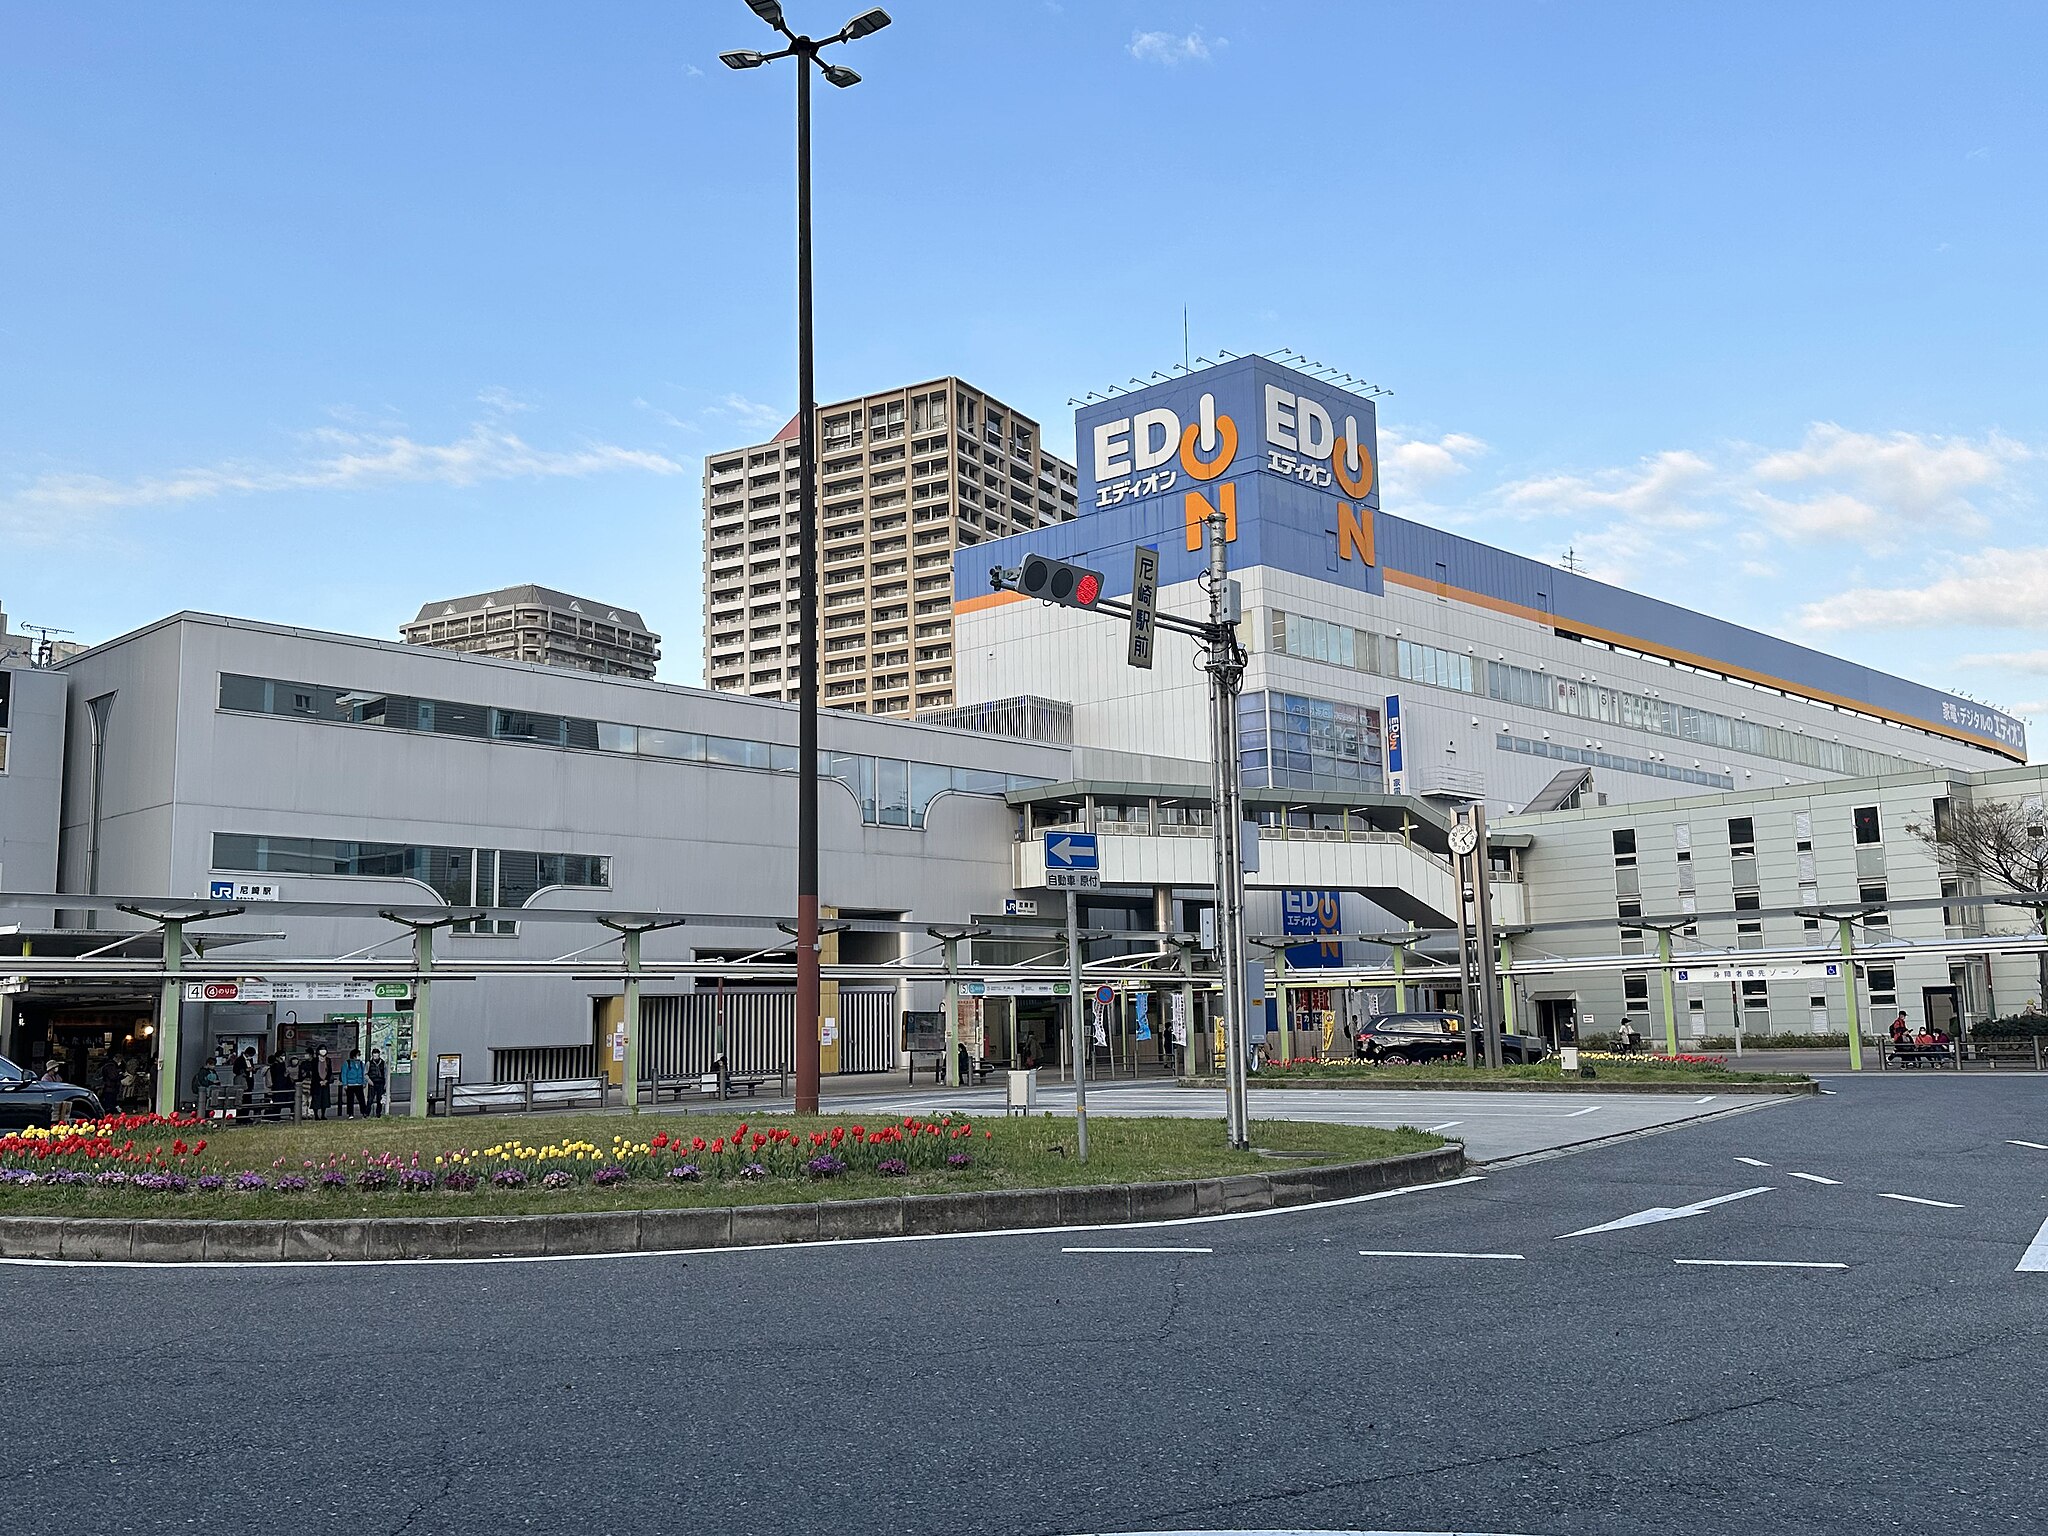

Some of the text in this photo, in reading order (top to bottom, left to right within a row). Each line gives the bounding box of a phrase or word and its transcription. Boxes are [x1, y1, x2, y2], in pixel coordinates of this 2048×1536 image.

[1267, 450, 1332, 487] エディオン
[1096, 470, 1177, 507] エディオン
[1134, 558, 1153, 658] 尼崎駅前
[1993, 715, 2024, 747] エディオン
[1048, 875, 1097, 887] 自動車 原付
[212, 887, 232, 899] JR
[1006, 903, 1016, 911] JR
[1287, 915, 1318, 927] エディオン
[191, 986, 200, 997] 4
